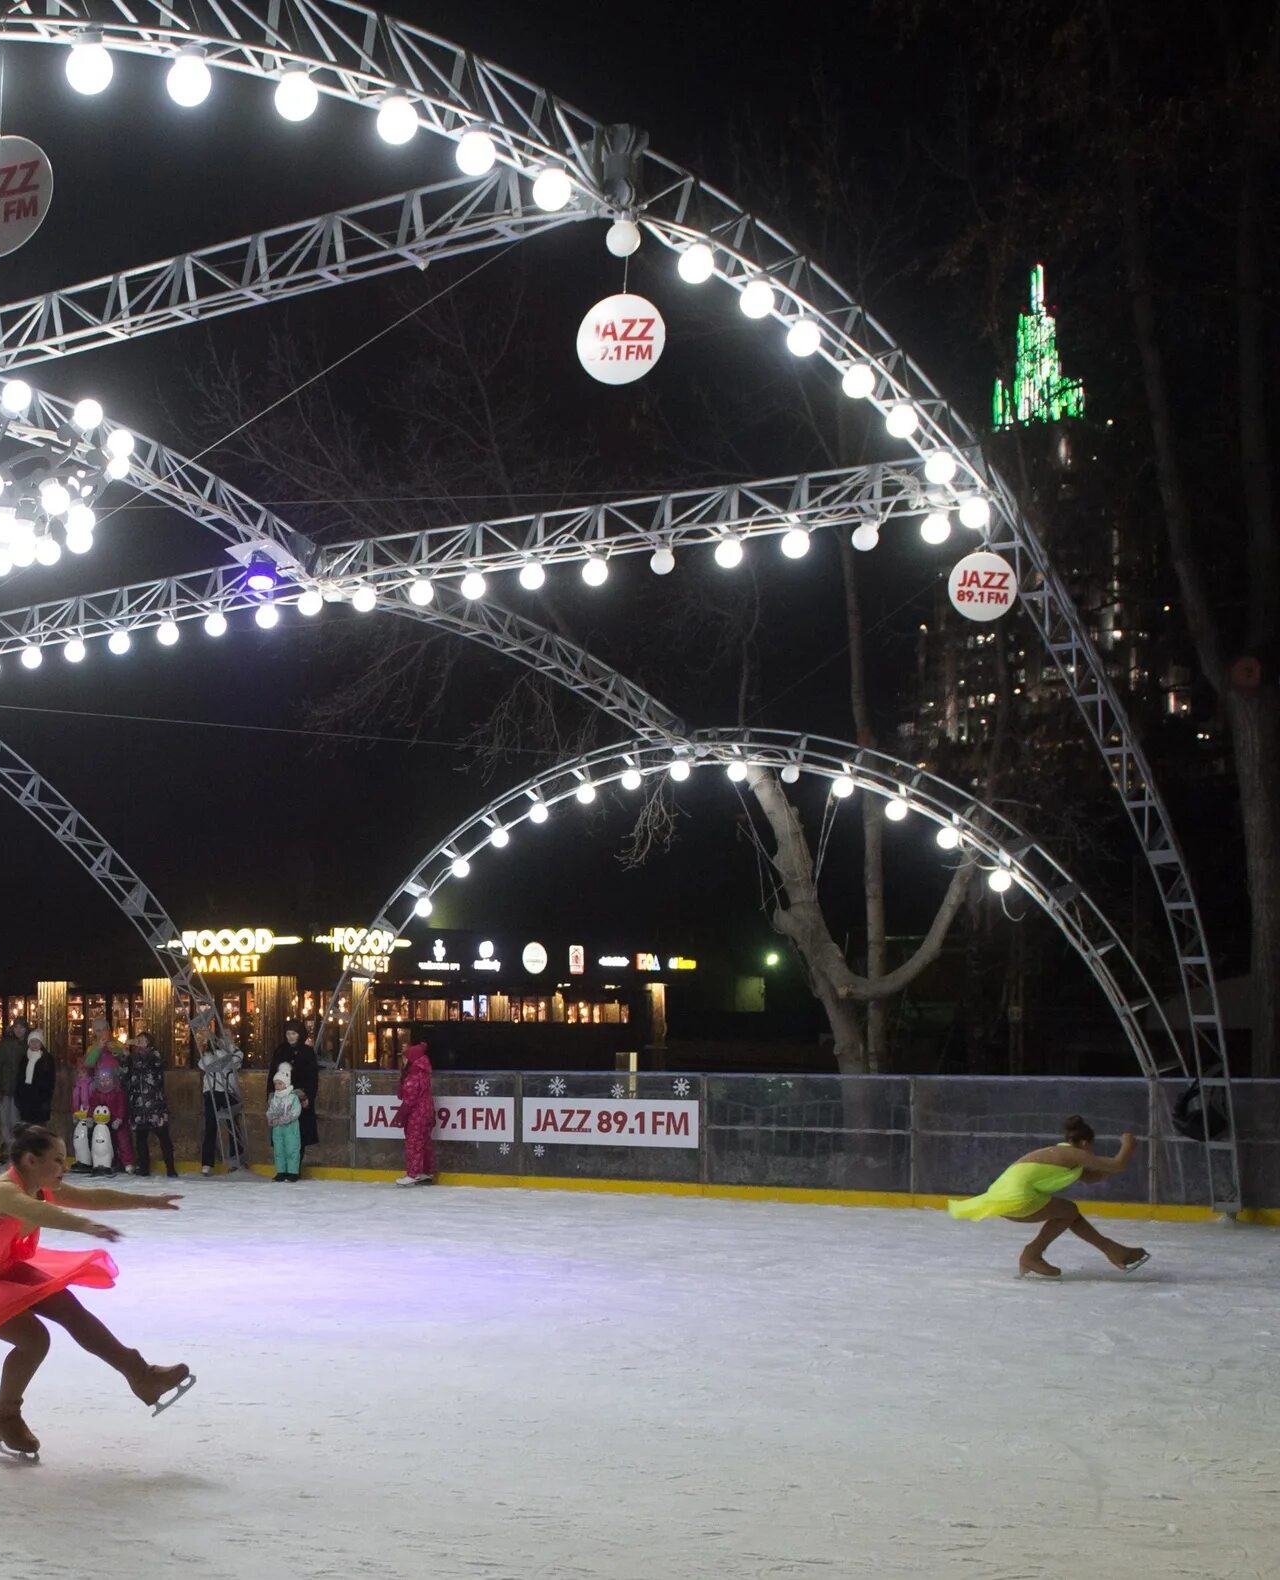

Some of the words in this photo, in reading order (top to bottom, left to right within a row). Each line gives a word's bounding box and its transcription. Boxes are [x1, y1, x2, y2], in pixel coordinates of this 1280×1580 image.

[3, 195, 39, 223] FM
[625, 344, 653, 360] FM
[958, 570, 1010, 590] JAZZ
[956, 589, 985, 604] 89.1
[987, 591, 1009, 605] FM
[192, 954, 261, 973] MARKET
[363, 1105, 404, 1129] JAZ
[431, 1107, 467, 1130] 9.1
[472, 1108, 506, 1131] FM
[531, 1108, 592, 1133] JAZZ
[597, 1110, 645, 1135] 89.1
[651, 1111, 689, 1136] FM
